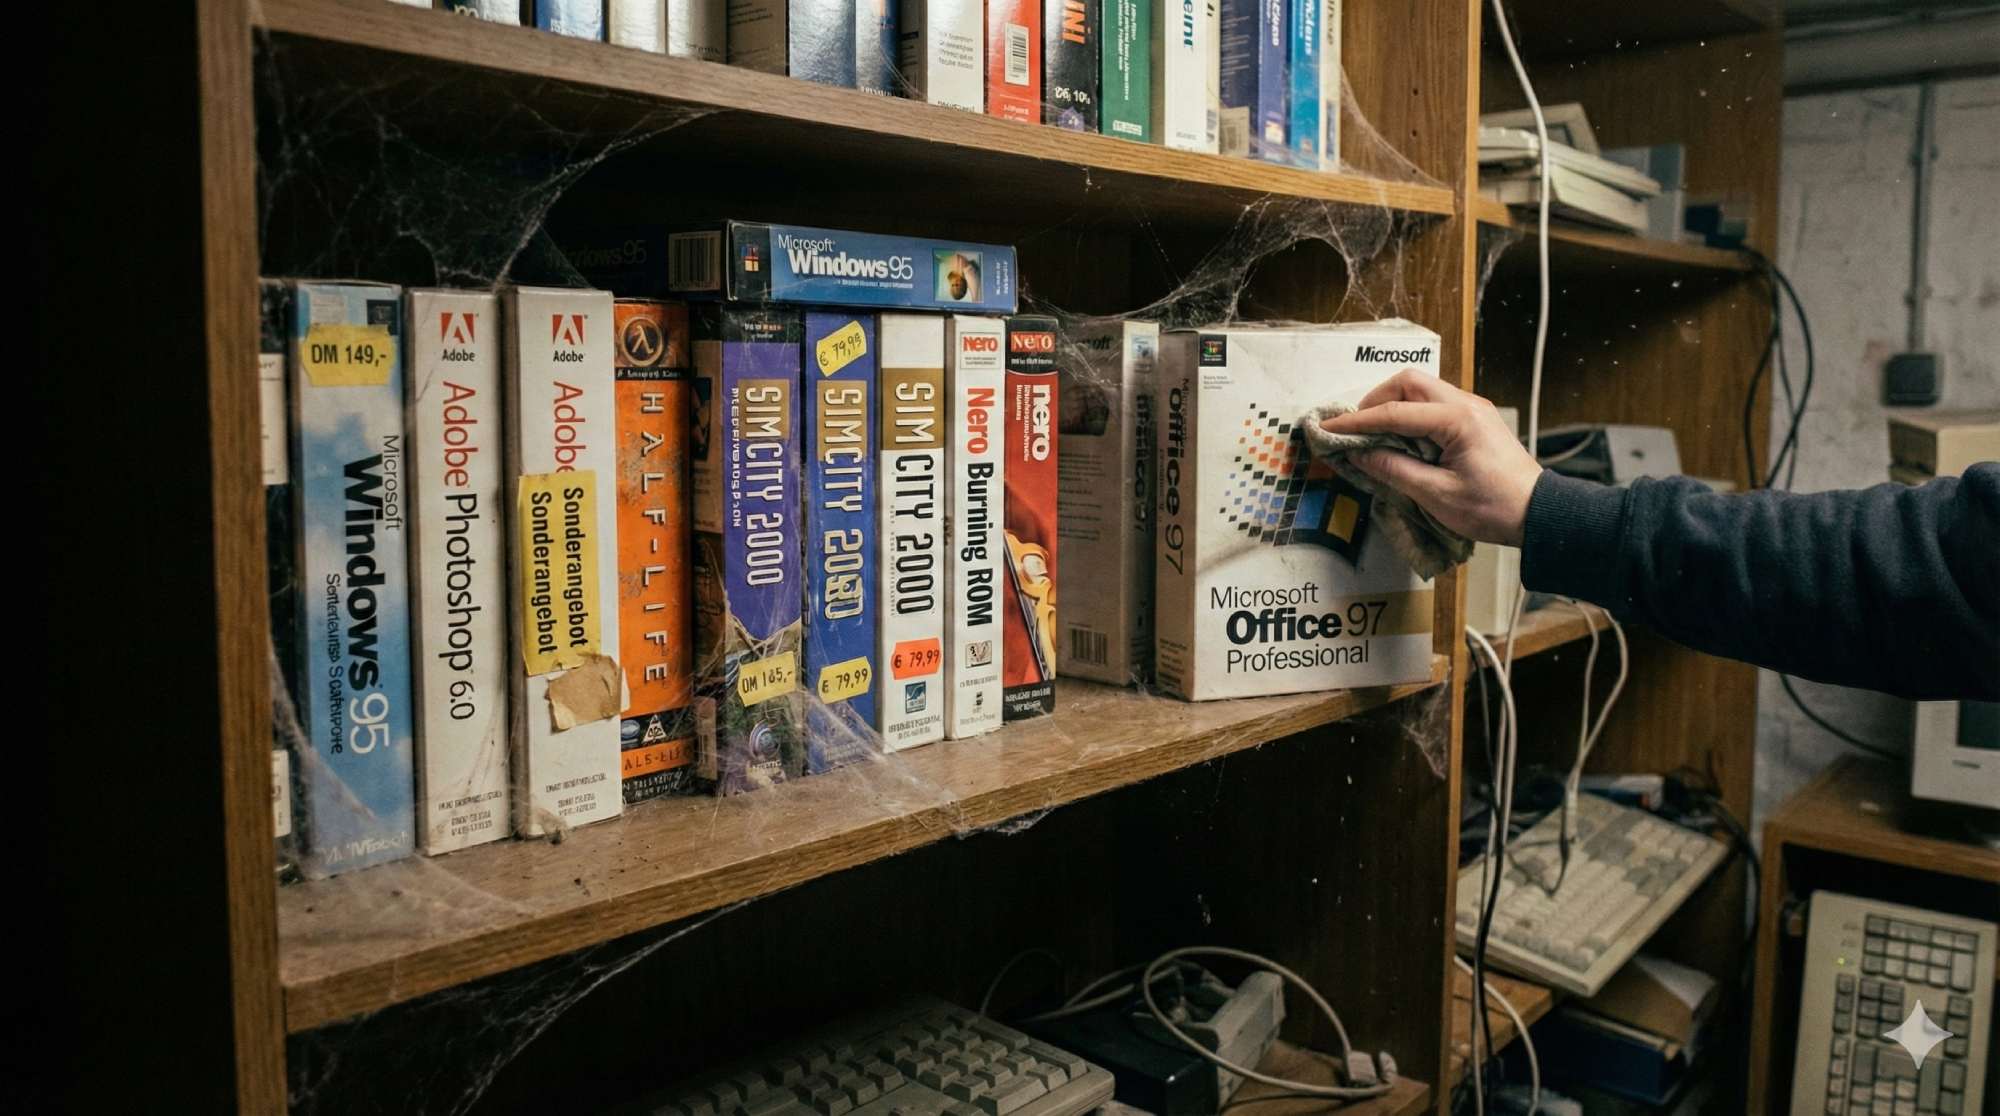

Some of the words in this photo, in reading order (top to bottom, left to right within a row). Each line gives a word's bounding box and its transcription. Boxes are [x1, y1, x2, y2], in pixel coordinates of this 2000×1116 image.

[778, 233, 833, 252] Microsoft
[788, 248, 888, 278] Windows
[889, 255, 913, 280] 95
[311, 344, 338, 364] DM
[346, 344, 387, 367] 149,-
[442, 350, 476, 362] Adobe
[552, 351, 584, 362] Adobe
[963, 335, 998, 353] Nero
[1012, 332, 1053, 350] Nero
[1355, 345, 1431, 363] Microsoft
[443, 381, 478, 487] Adobe
[966, 387, 995, 455] Nero
[1032, 384, 1051, 462] nero
[383, 435, 403, 531] Microsoft
[961, 462, 994, 562] Burning
[344, 453, 385, 691] Windows
[531, 491, 558, 655] Sonderangebot
[563, 487, 589, 648] Sonderangebot
[745, 512, 784, 587] 2000
[895, 533, 935, 615] 2000
[1166, 523, 1184, 576] 97
[439, 493, 482, 671] Photoshop
[966, 567, 993, 627] ROM
[1210, 582, 1319, 609] Microsoft
[1226, 607, 1343, 645] Office
[1346, 601, 1389, 637] 97
[1226, 640, 1369, 674] Professional
[350, 693, 390, 754] 95
[449, 680, 476, 721] 6.0
